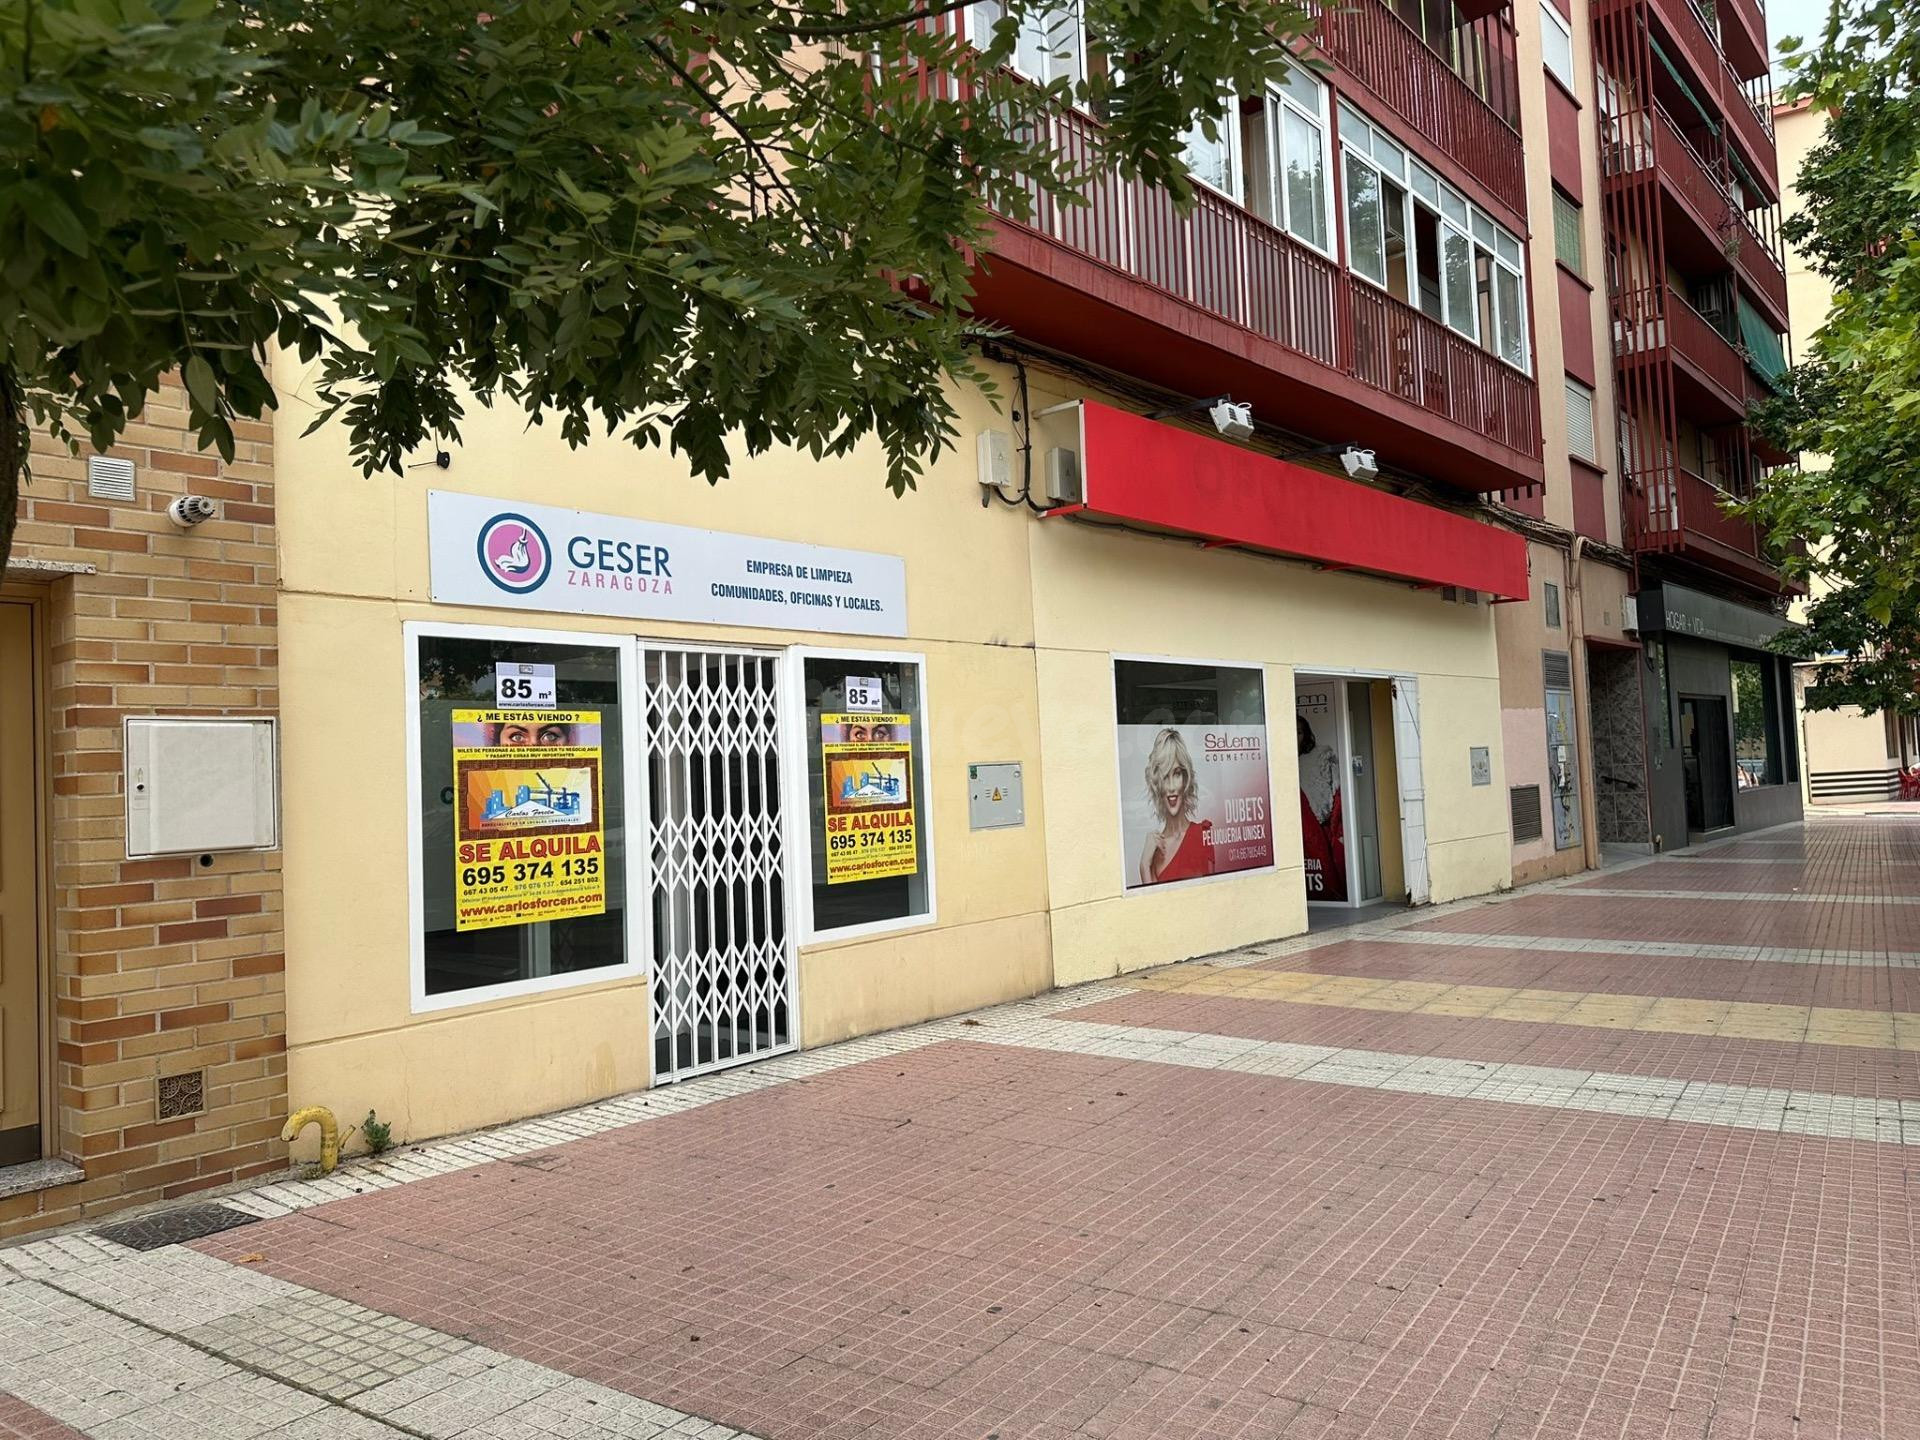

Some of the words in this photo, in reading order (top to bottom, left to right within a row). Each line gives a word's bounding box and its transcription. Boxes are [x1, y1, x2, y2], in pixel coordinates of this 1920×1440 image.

[567, 536, 672, 577] GESER
[568, 570, 672, 595] ZARAGOZA
[746, 560, 794, 578] EMPRESA
[796, 565, 808, 579] DE
[811, 567, 853, 584] LIMPIEZA
[711, 582, 788, 605] COMUNIDADES,
[790, 591, 833, 607] OFICINAS
[835, 595, 841, 608] Y
[843, 596, 884, 612] LOCALES.
[501, 678, 532, 699] 85
[849, 688, 868, 705] 85
[477, 714, 483, 723] ¿
[485, 713, 500, 721] ME
[503, 712, 534, 721] ESTÁS
[537, 713, 572, 722] VIENDO
[1204, 732, 1260, 749] Salerm
[1205, 752, 1262, 762] COSMETICS
[1225, 796, 1264, 824] DUBETS
[828, 816, 847, 833] SE
[851, 811, 913, 831] ALQUILA
[830, 834, 856, 850] 695
[860, 831, 885, 847] 374
[889, 829, 912, 844] 135
[1202, 826, 1242, 846] PELUQUERIA
[1242, 824, 1266, 842] UNISEX
[459, 843, 491, 864] SE
[500, 835, 601, 861] ALQUILA
[462, 865, 505, 886] 695
[513, 861, 554, 881] 374
[561, 857, 599, 876] 135
[829, 857, 915, 873] www.carlosforcen.com
[1306, 873, 1323, 891] TS
[460, 893, 602, 917] www.carlosforcen.com
